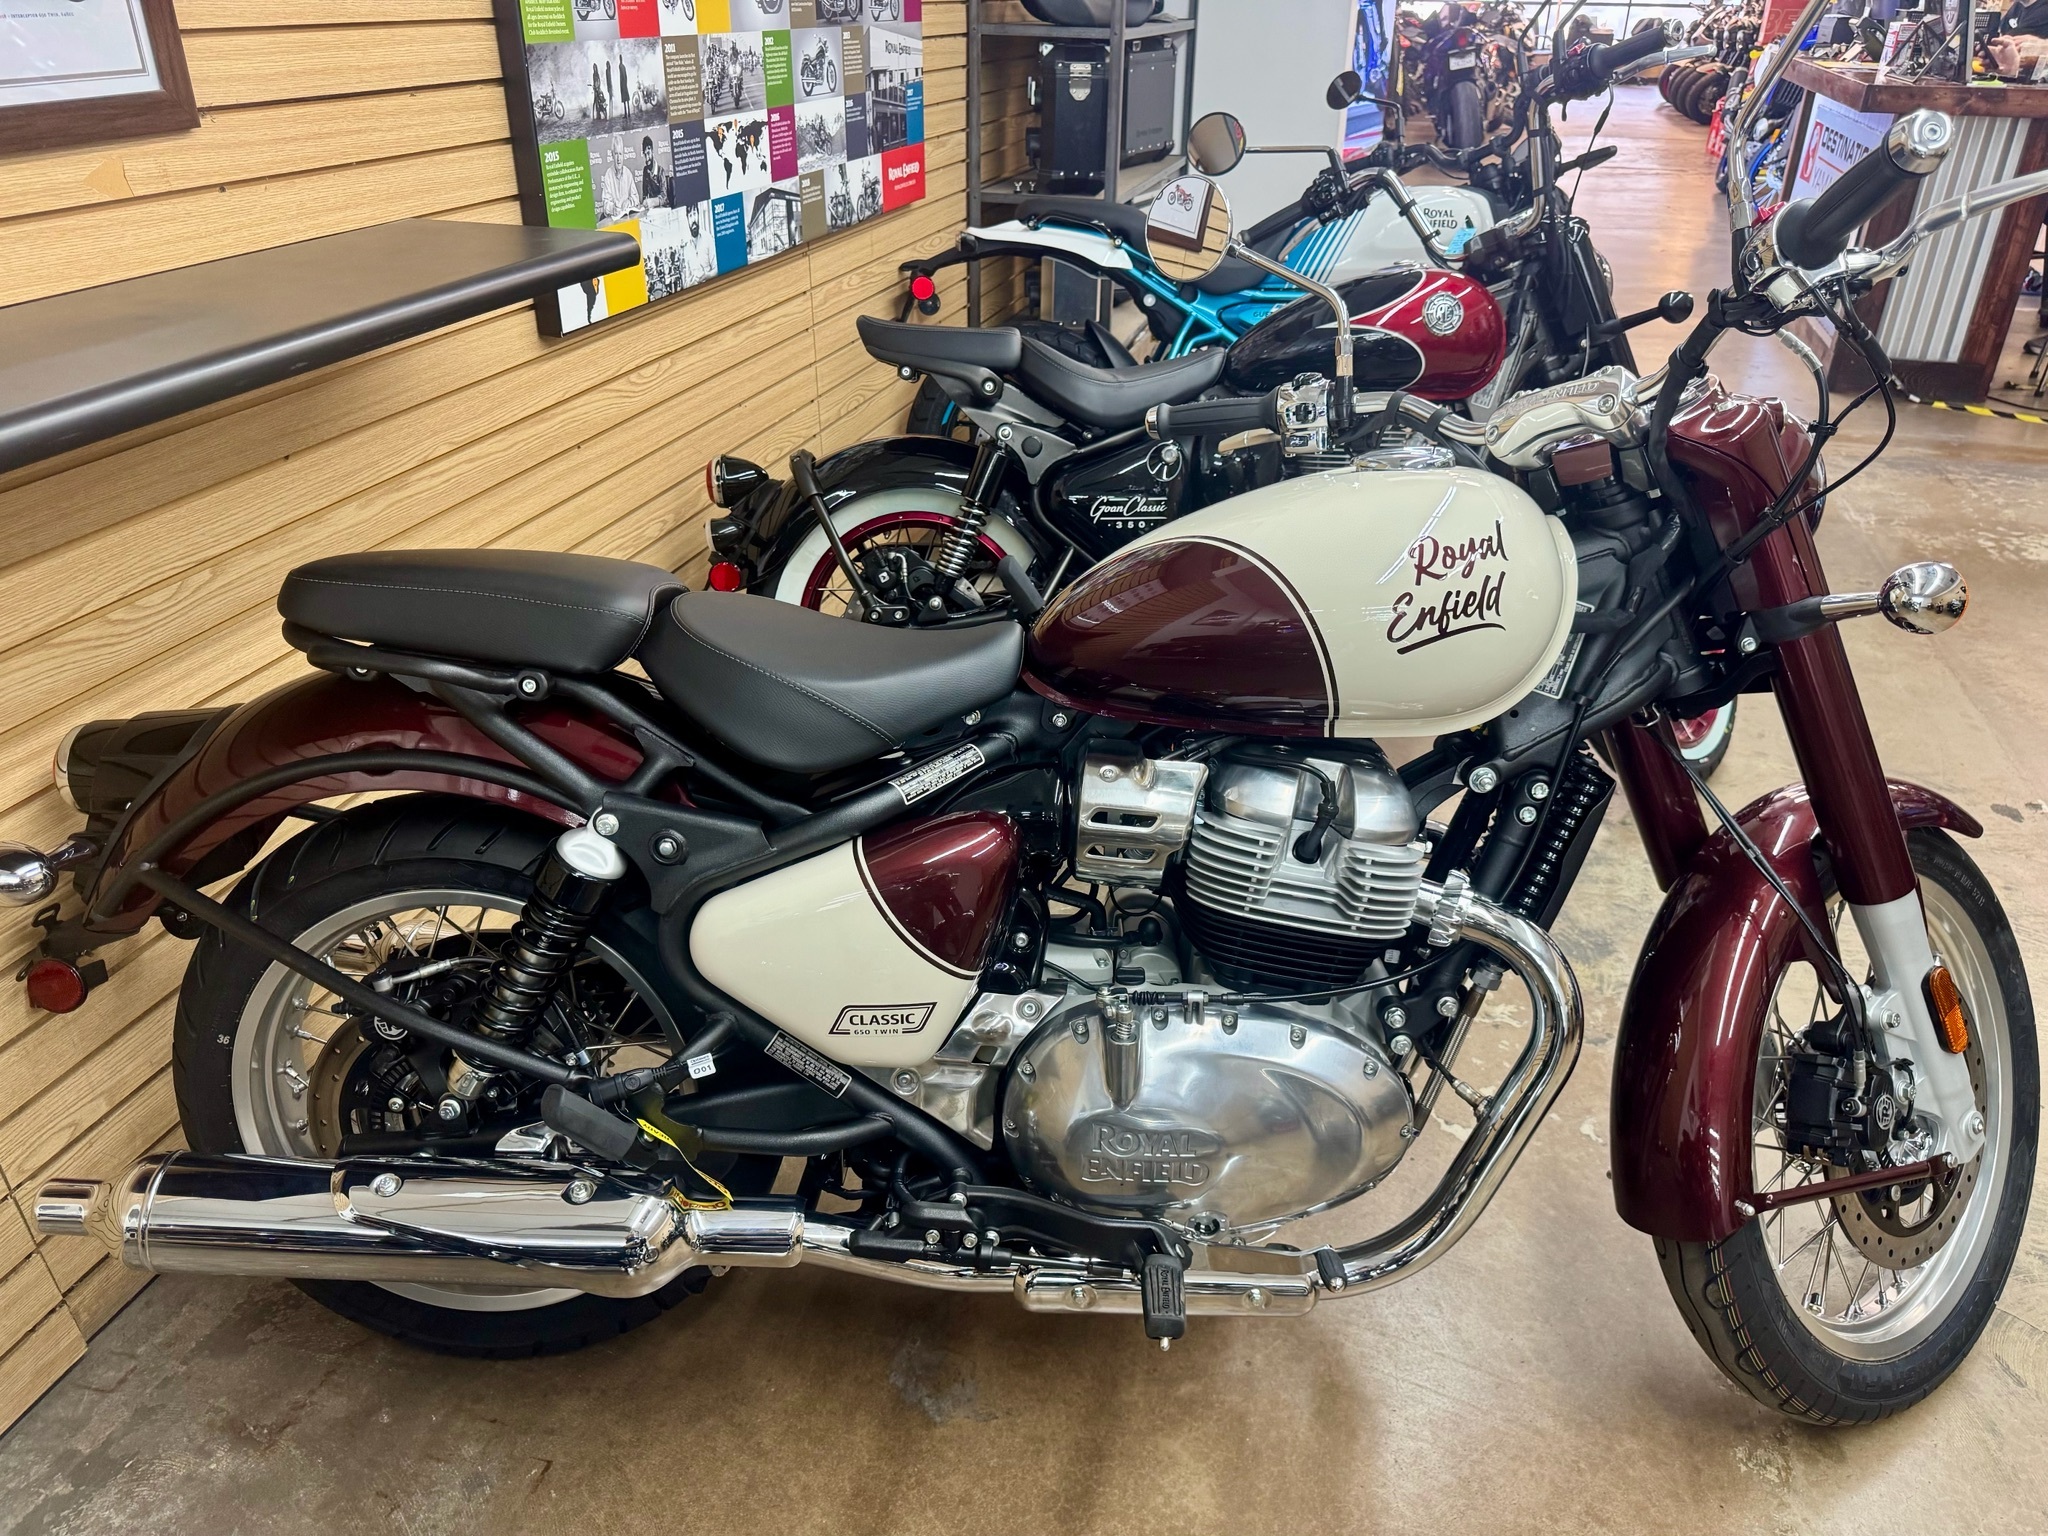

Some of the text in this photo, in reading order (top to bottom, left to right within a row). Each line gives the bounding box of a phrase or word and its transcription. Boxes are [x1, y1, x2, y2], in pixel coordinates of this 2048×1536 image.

[885, 39, 898, 54] ROYAL
[544, 150, 560, 163] 2015
[888, 167, 903, 181] ROYAL
[1423, 208, 1454, 218] ROYAL
[1430, 219, 1458, 229] FIELD
[1090, 496, 1168, 524] Goan Classic
[1408, 519, 1509, 586] Royal
[1387, 570, 1506, 643] Enfield
[849, 1013, 915, 1026] CLASSIC
[216, 1033, 230, 1045] 36
[1091, 1122, 1197, 1158] ROYAL
[1080, 1155, 1210, 1187] ENFIELD
[1160, 1269, 1171, 1310] ROYAL ENFIELD
